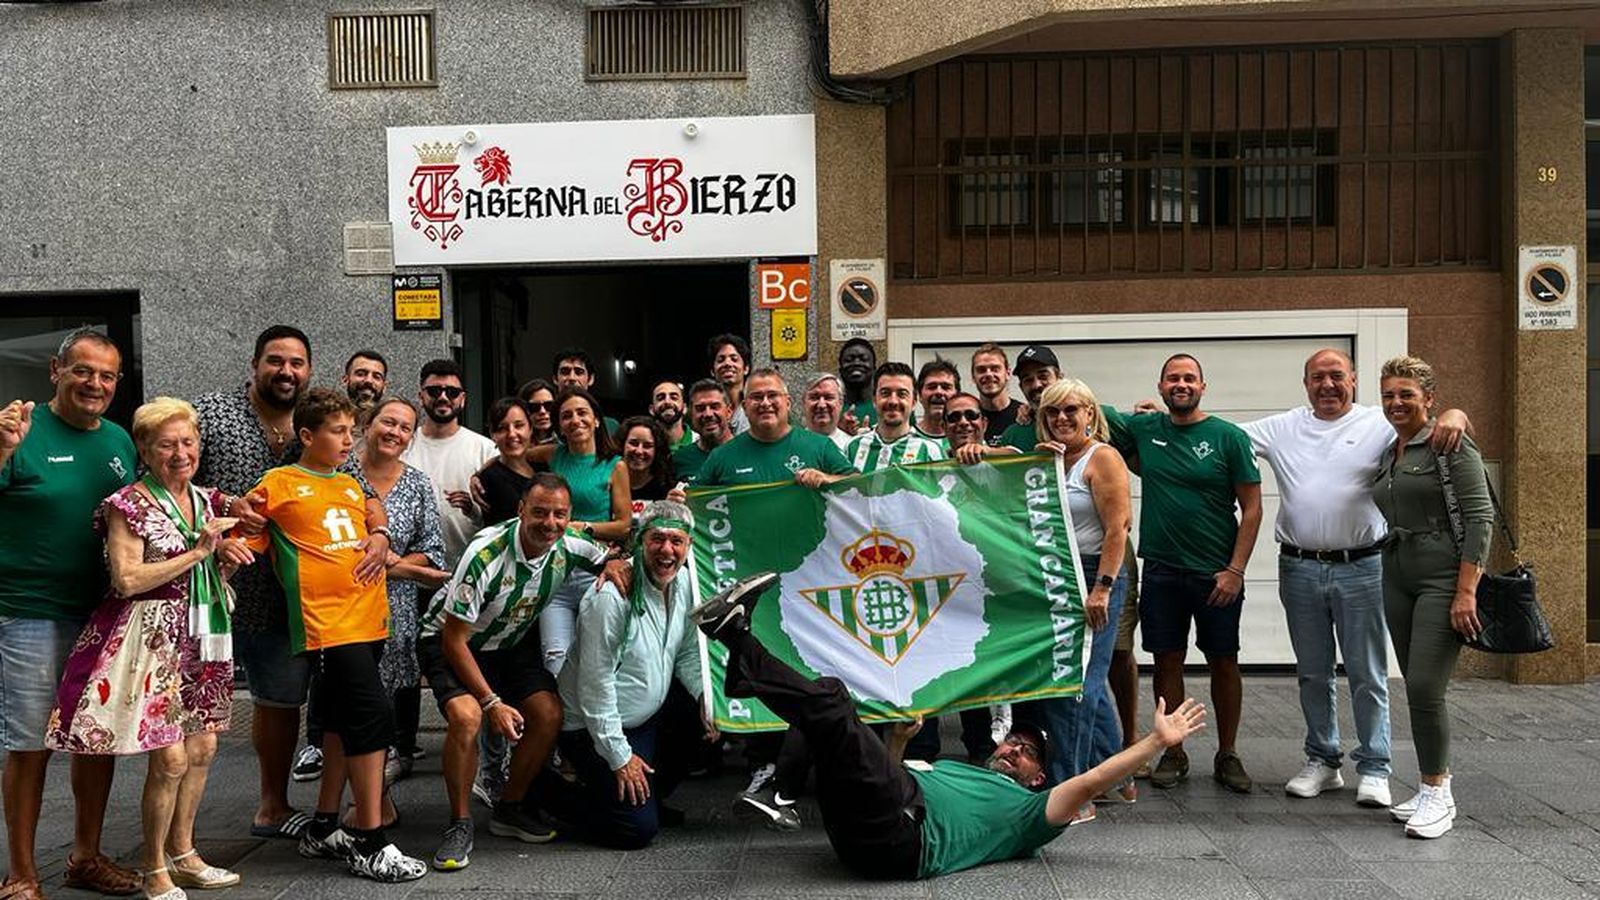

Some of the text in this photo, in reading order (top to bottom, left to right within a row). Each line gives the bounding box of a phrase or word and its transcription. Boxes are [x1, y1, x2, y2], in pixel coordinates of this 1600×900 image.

[1538, 166, 1557, 182] 39
[408, 158, 797, 250] TABERNA DEL BIERZO
[761, 270, 808, 303] Bc
[322, 508, 358, 541] fi
[1024, 467, 1076, 681] GRAN CANARIA
